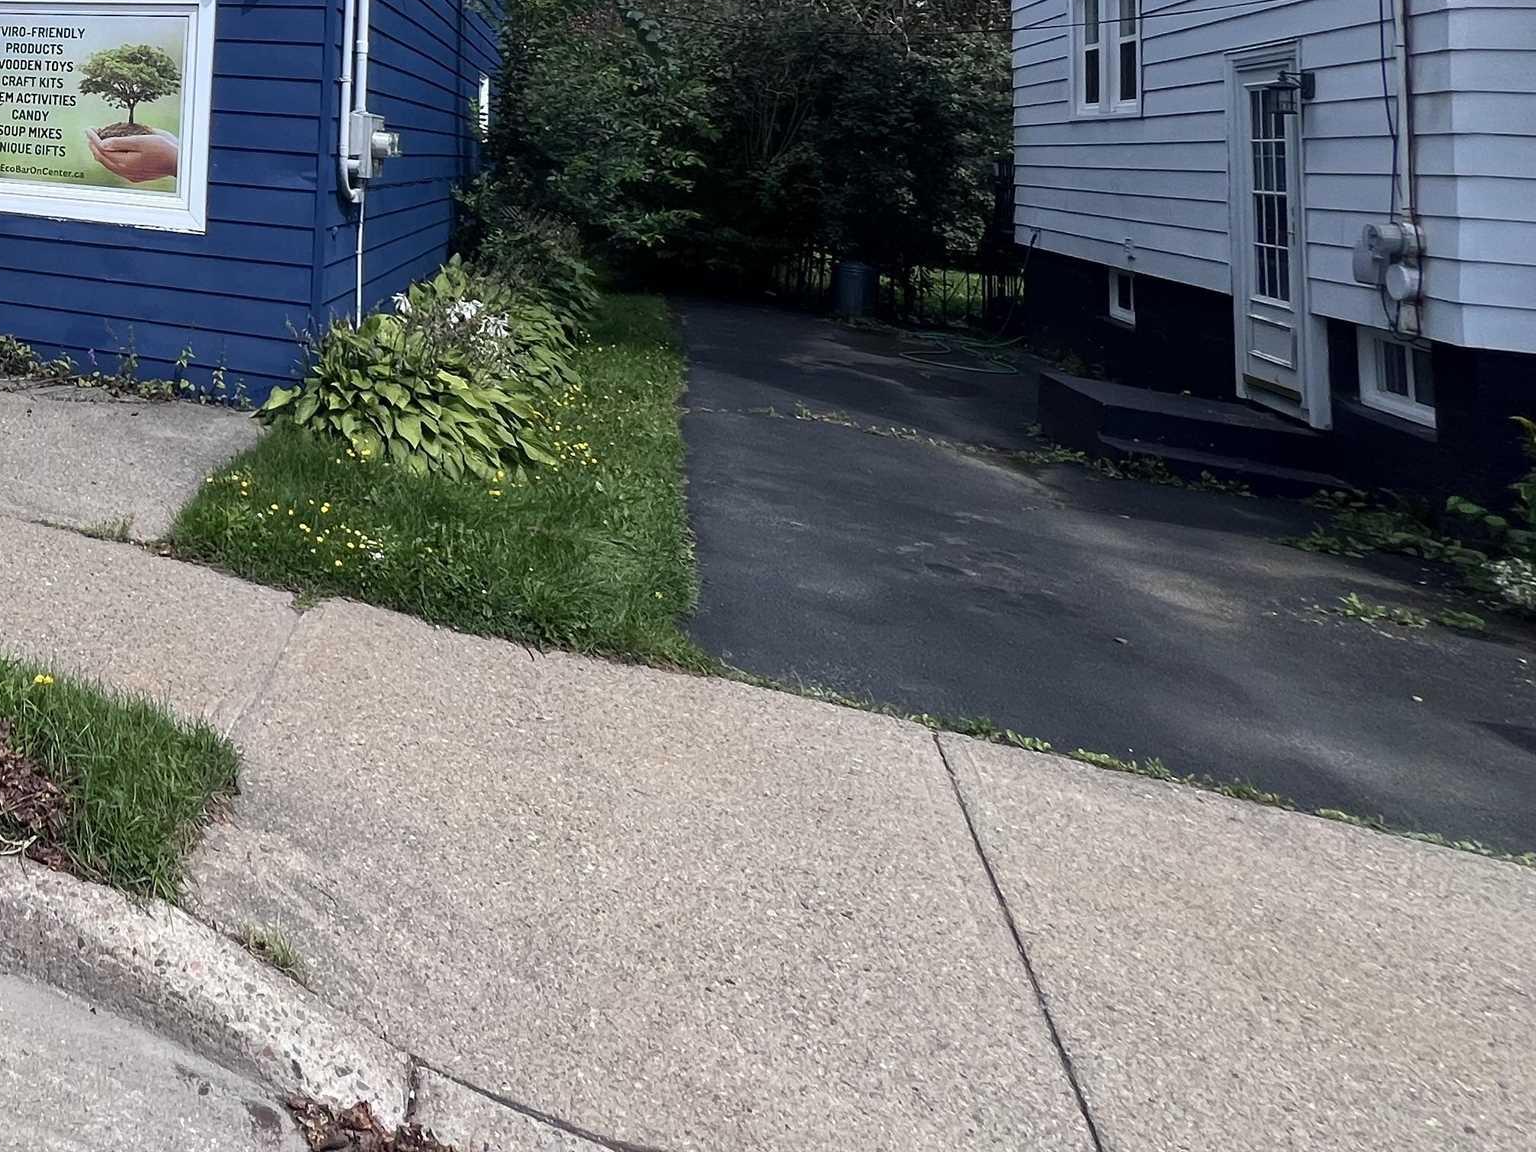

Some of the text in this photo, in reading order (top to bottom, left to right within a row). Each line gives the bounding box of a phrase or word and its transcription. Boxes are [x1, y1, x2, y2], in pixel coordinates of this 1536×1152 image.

[5, 43, 64, 55] PRODUCTS
[45, 60, 74, 72] TOYS
[2, 75, 64, 89] CRAFT KITS
[16, 93, 77, 107] ACTIVITIES
[11, 109, 50, 122] CANDY
[28, 127, 63, 140] MIXES
[35, 144, 66, 158] GIFTS
